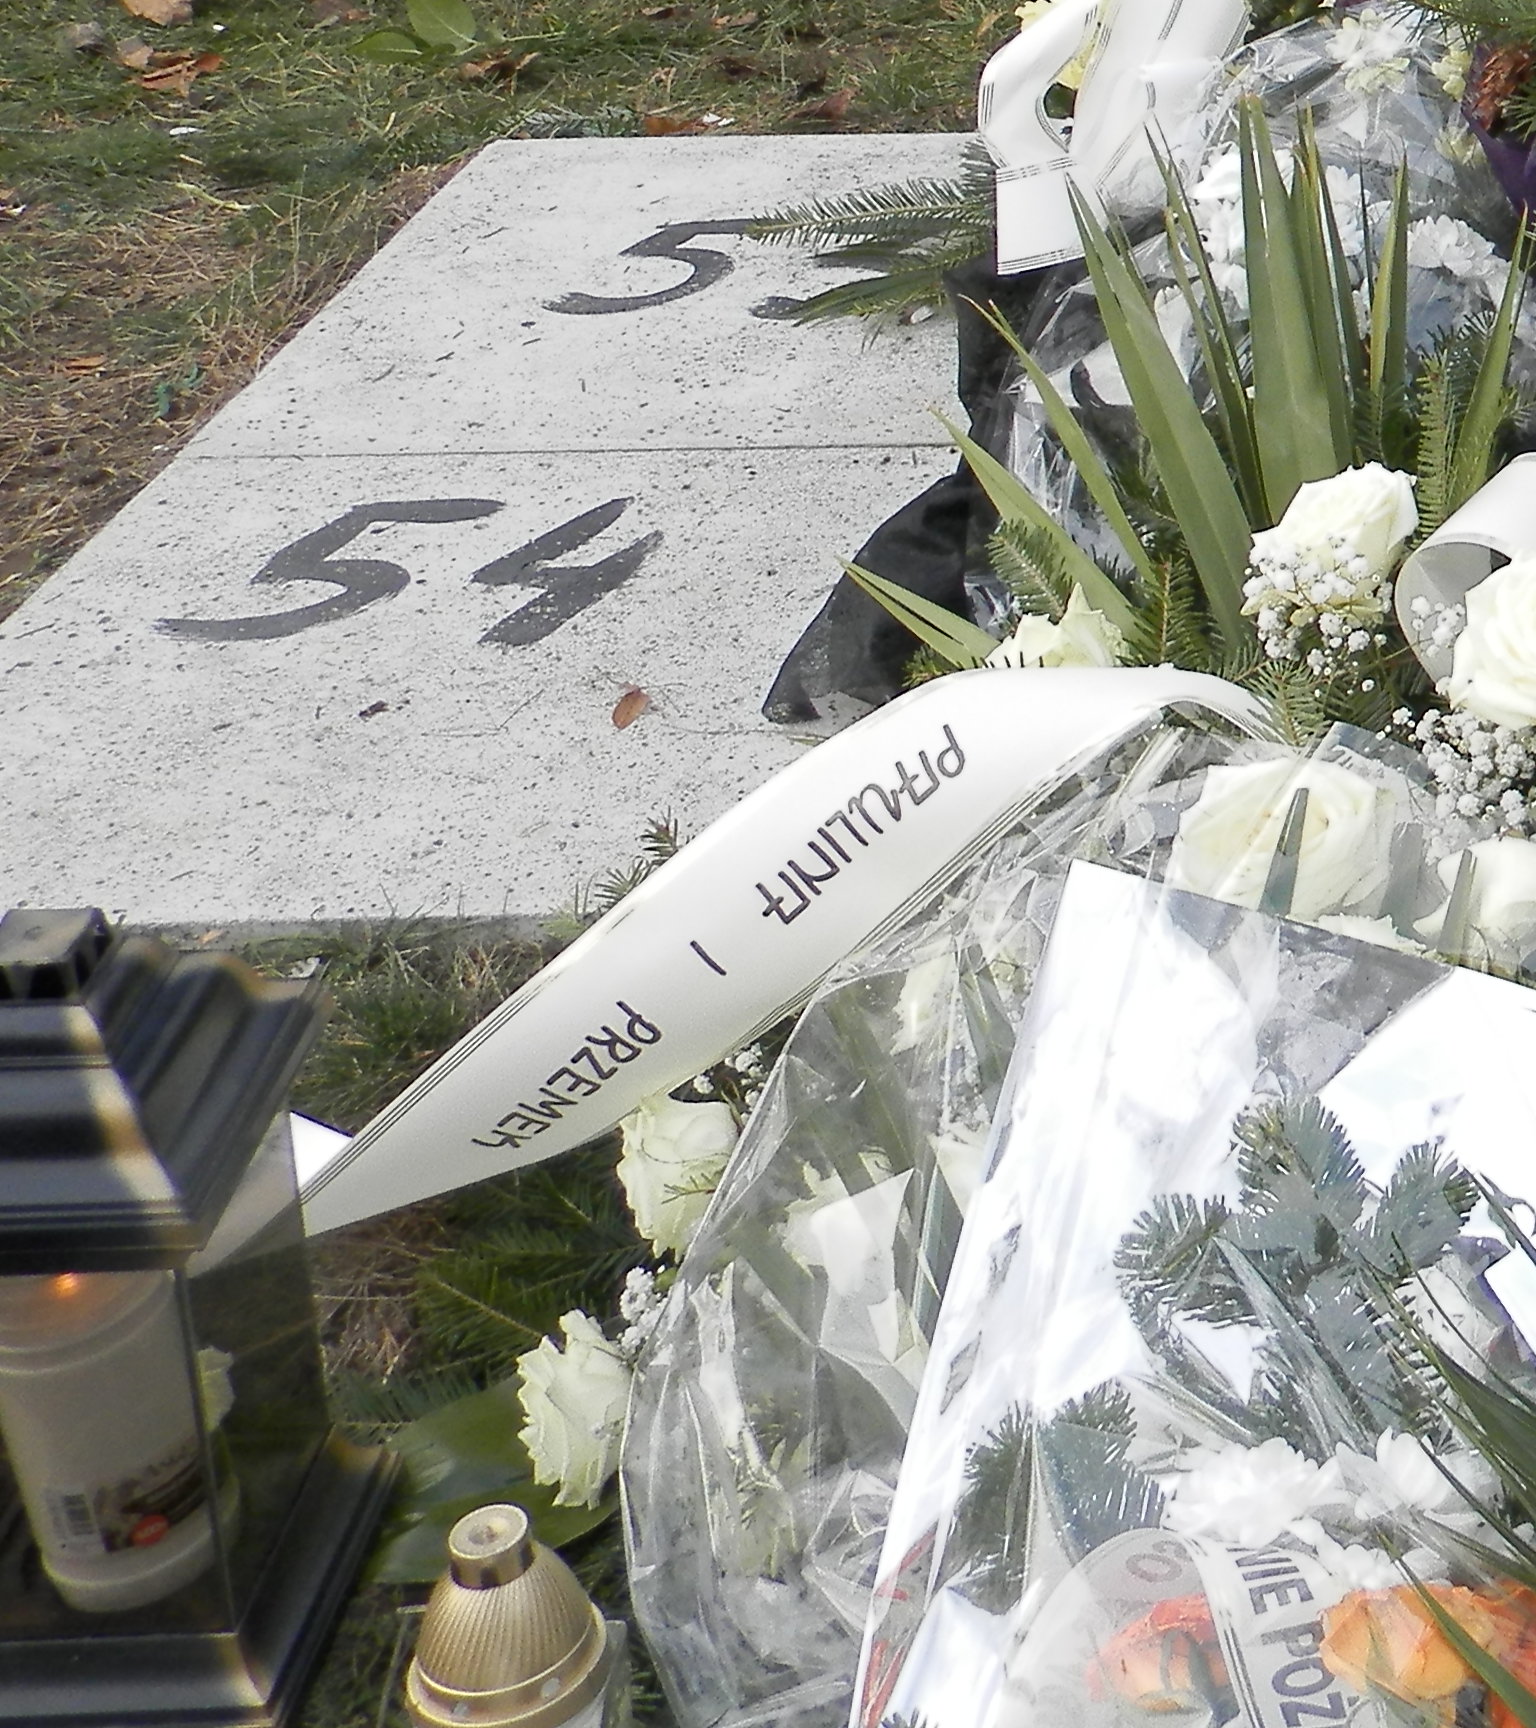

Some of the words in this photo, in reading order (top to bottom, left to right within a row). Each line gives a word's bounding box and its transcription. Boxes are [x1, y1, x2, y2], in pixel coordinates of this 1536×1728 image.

[154, 496, 665, 647] 54
[757, 722, 966, 926] PAULINA
[471, 999, 664, 1150] PRZEMEK
